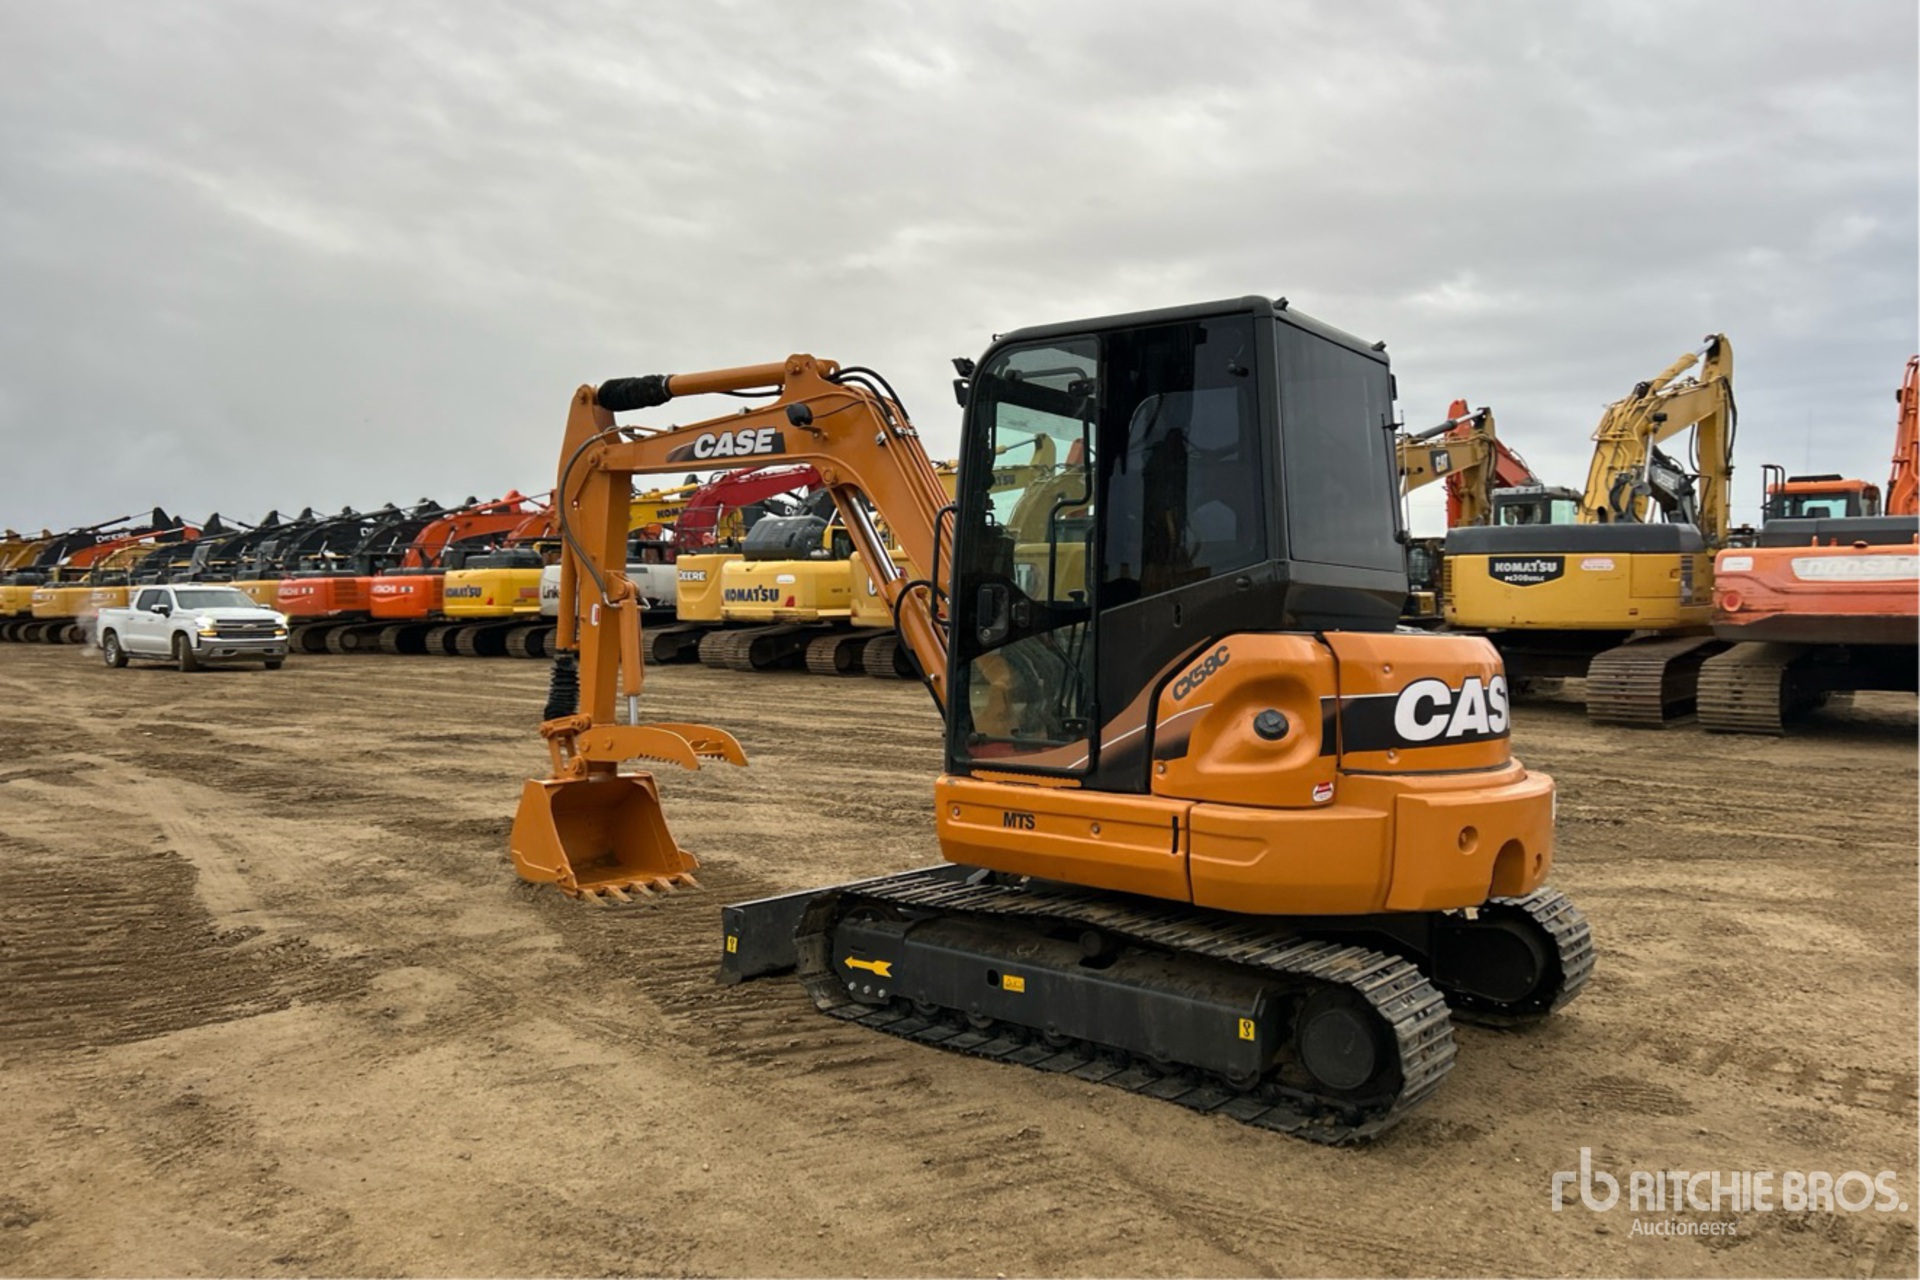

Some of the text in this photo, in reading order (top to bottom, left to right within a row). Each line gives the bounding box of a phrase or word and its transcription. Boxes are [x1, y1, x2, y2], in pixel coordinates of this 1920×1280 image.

[693, 427, 776, 459] CASE
[1435, 453, 1448, 473] CAT
[656, 506, 684, 519] KOM
[1495, 560, 1557, 572] KOMATSU
[679, 571, 706, 581] DEERE
[445, 585, 482, 598] KOMATSU
[725, 585, 779, 602] KOMATSU
[1172, 645, 1230, 701] CX58C
[1394, 674, 1511, 742] CAS
[1003, 811, 1036, 830] MTS
